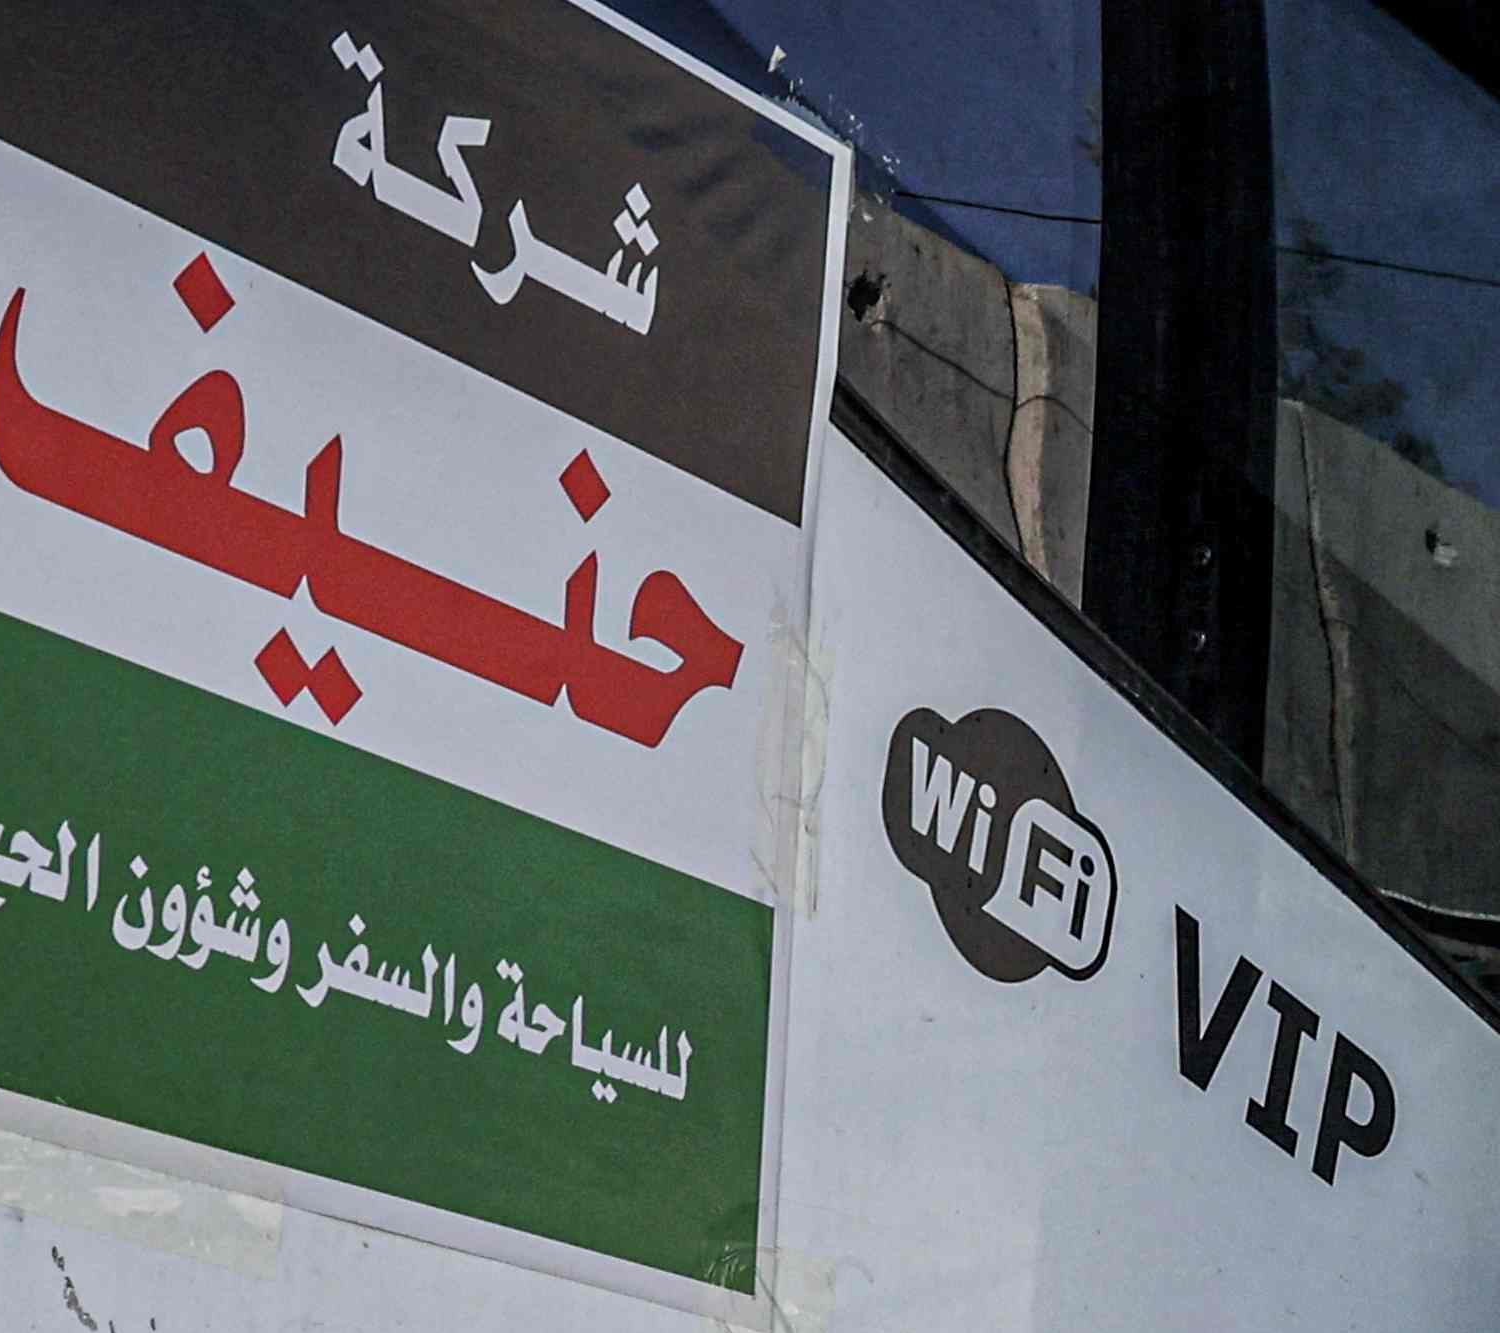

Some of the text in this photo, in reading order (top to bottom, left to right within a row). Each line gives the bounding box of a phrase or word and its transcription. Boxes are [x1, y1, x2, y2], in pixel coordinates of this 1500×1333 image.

[332, 31, 659, 334] شركة
[112, 855, 290, 993] وشؤون
[295, 913, 484, 1055] والسفر
[498, 958, 692, 1103] للسياحة
[1175, 903, 1396, 1187] VIP
